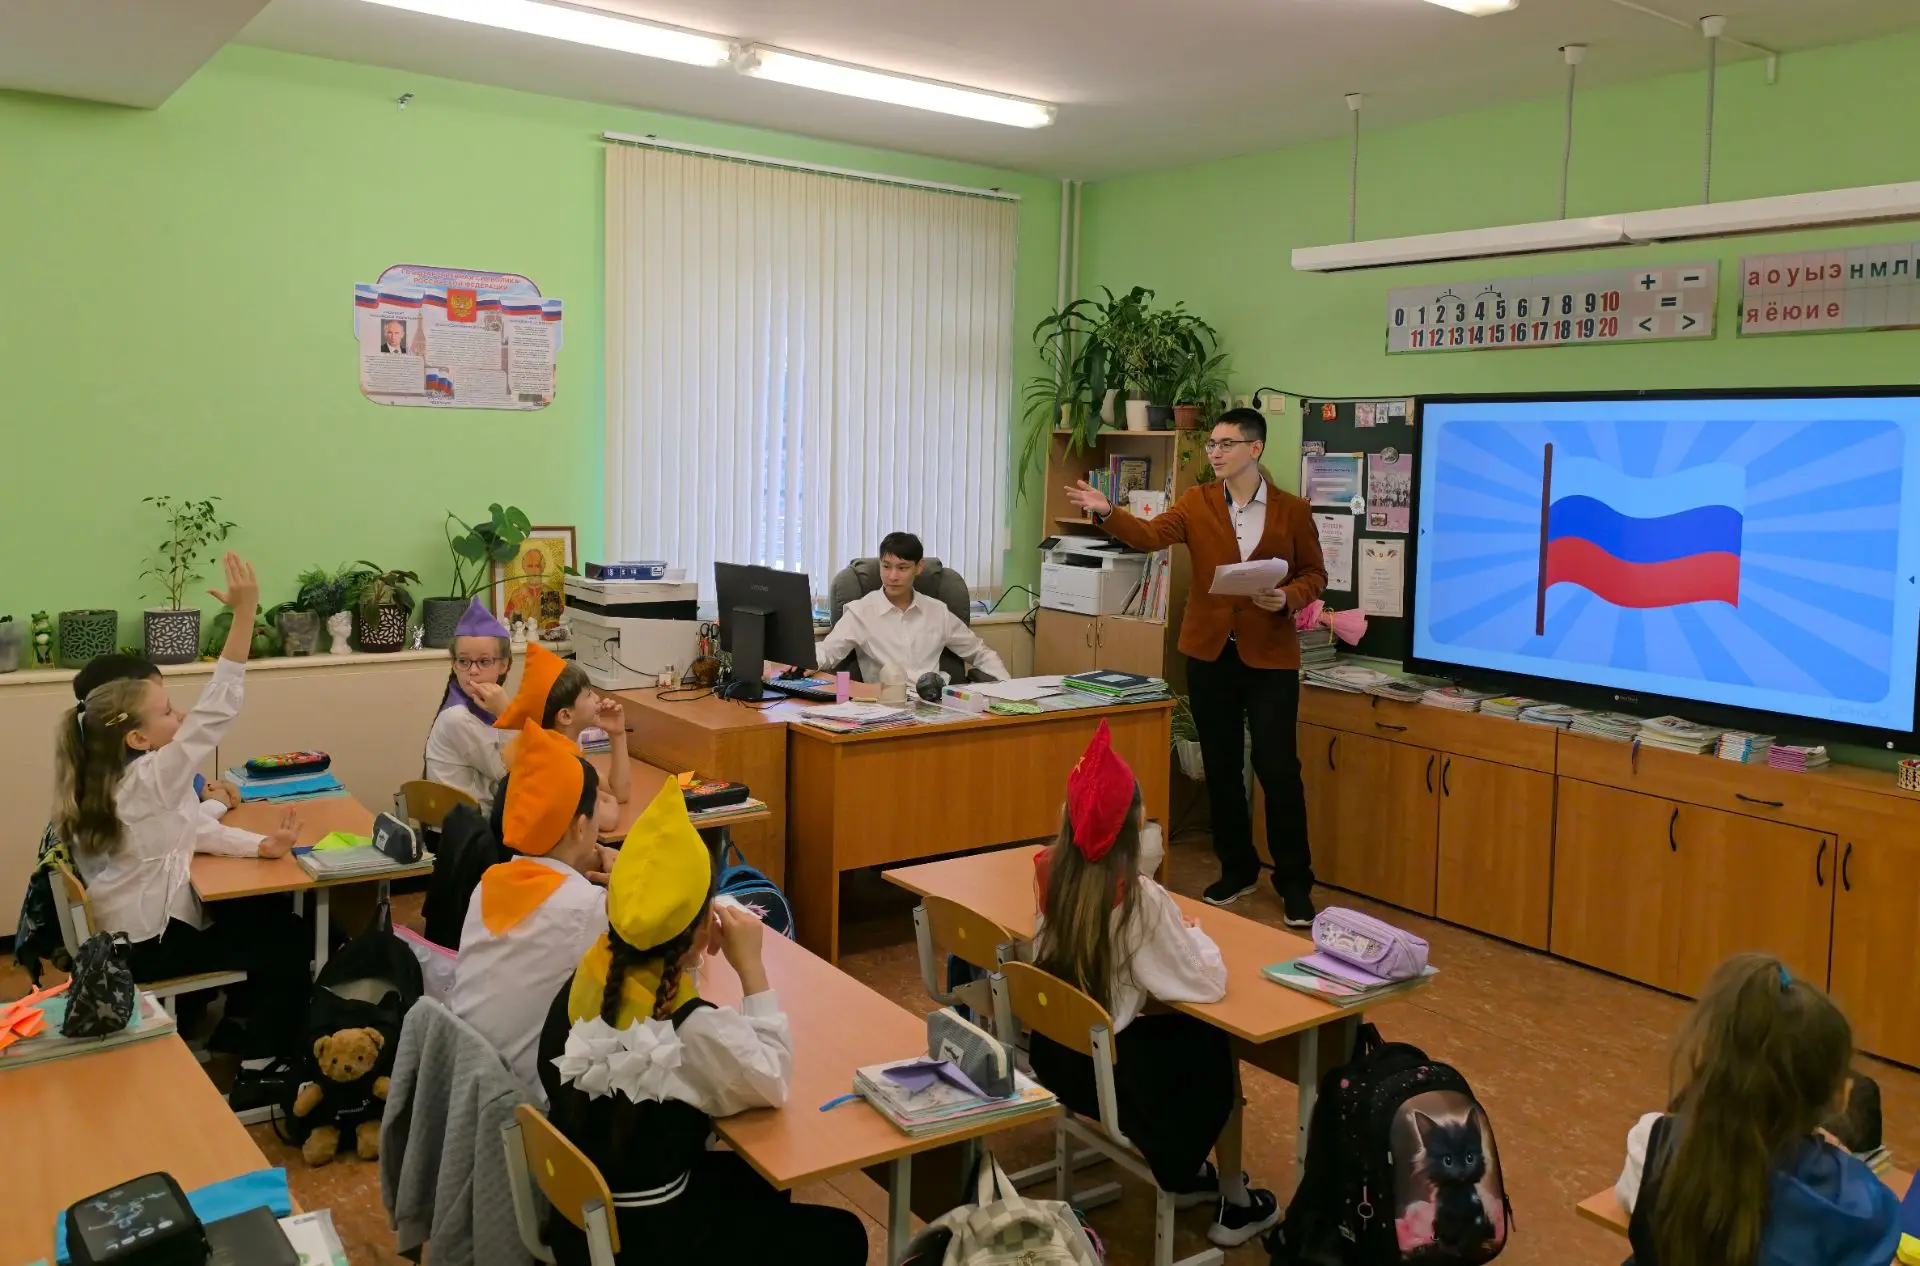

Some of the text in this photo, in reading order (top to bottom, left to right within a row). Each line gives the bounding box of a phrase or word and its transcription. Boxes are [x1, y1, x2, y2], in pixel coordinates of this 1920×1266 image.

[1395, 291, 1619, 325] 0 1 2 3 4 5 6 7 8 9 10
[1411, 317, 1618, 347] 11 12 13 14 15 16 17 18 19 20
